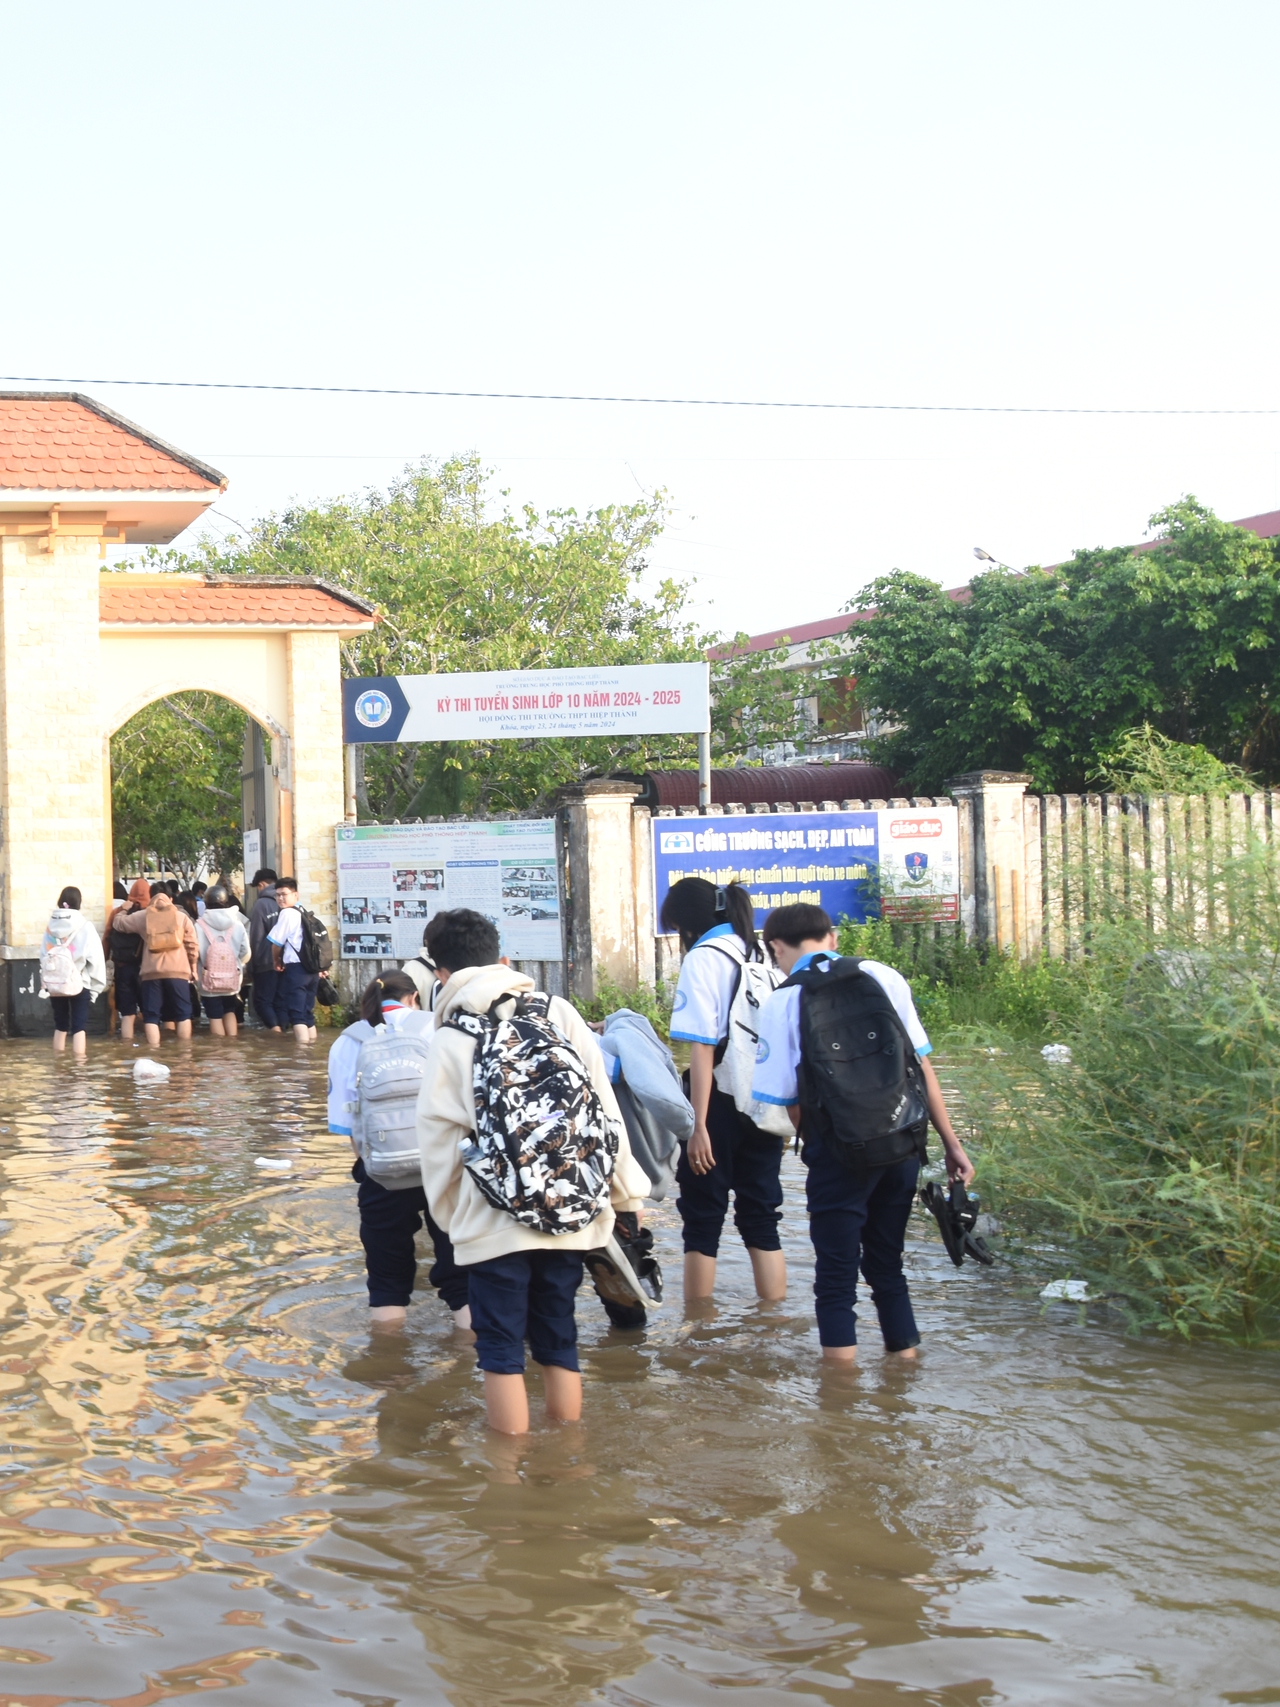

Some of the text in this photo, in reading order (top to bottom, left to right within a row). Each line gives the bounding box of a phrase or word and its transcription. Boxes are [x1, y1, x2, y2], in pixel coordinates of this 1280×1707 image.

[437, 696, 451, 713] KỲ
[454, 698, 471, 712] THI
[474, 691, 509, 711] TUYỂN
[512, 695, 539, 710] SINH
[542, 691, 563, 709] LỚP
[567, 694, 580, 708] 10
[583, 690, 610, 707] NĂM
[613, 692, 641, 706] 2024
[653, 690, 681, 705] 2025
[479, 715, 493, 723] HỘI
[494, 714, 517, 722] ĐỒNG
[533, 712, 566, 720] TRƯỜNG
[590, 712, 608, 720] HIỆP
[609, 710, 637, 718] THÀNH
[520, 724, 536, 732] ngày
[558, 722, 576, 730] tháng
[891, 821, 918, 837] giáo
[695, 825, 875, 853] CỔNG TRƯỜNG SẠCH, ĐẸP, AN TOÀN
[755, 864, 783, 884] chuẩn
[782, 866, 797, 882] khi
[797, 864, 816, 884] ngồi
[816, 865, 834, 881] trên
[835, 867, 845, 880] xe
[770, 894, 781, 908] xe
[371, 1059, 422, 1078] ADVENTURE
